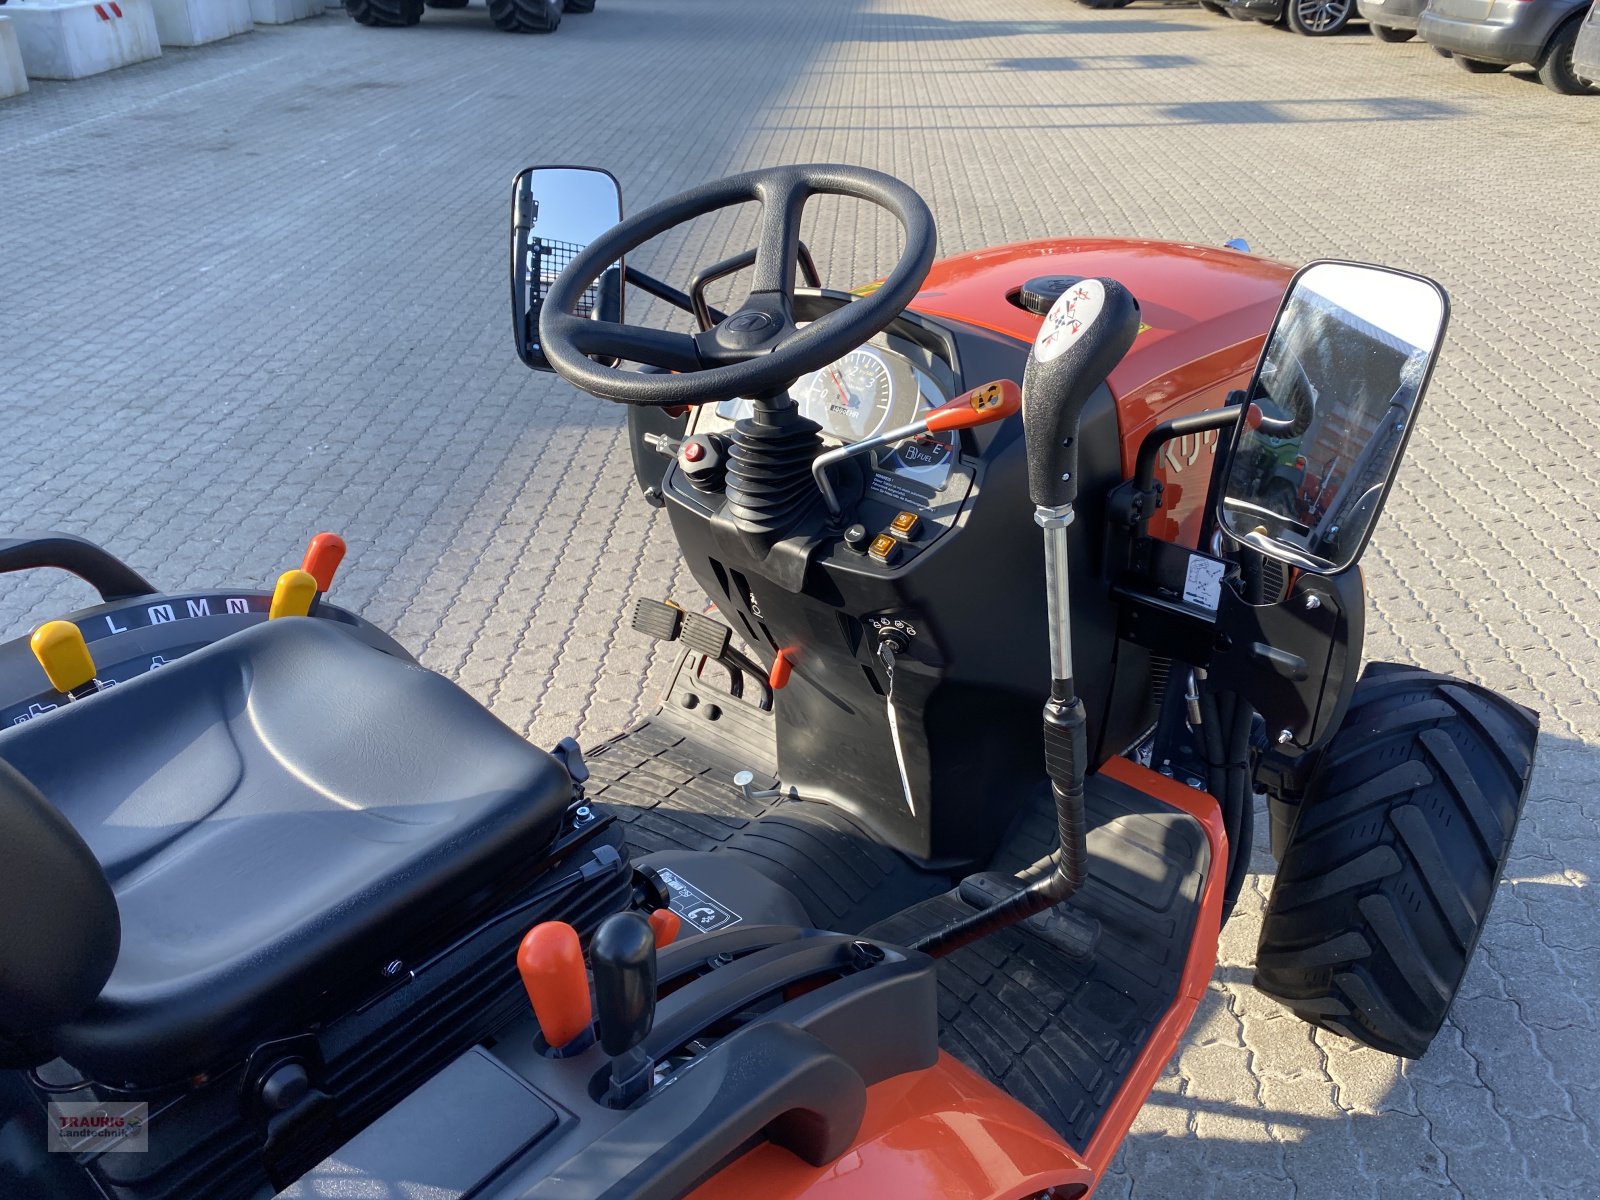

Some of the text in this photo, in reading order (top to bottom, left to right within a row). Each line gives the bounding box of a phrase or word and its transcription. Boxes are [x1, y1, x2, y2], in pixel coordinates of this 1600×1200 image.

[848, 366, 859, 377] 2
[865, 377, 876, 388] 3
[820, 388, 829, 399] 0
[933, 443, 943, 454] E
[917, 452, 932, 463] FUEL
[105, 615, 127, 634] L
[187, 598, 210, 618] M
